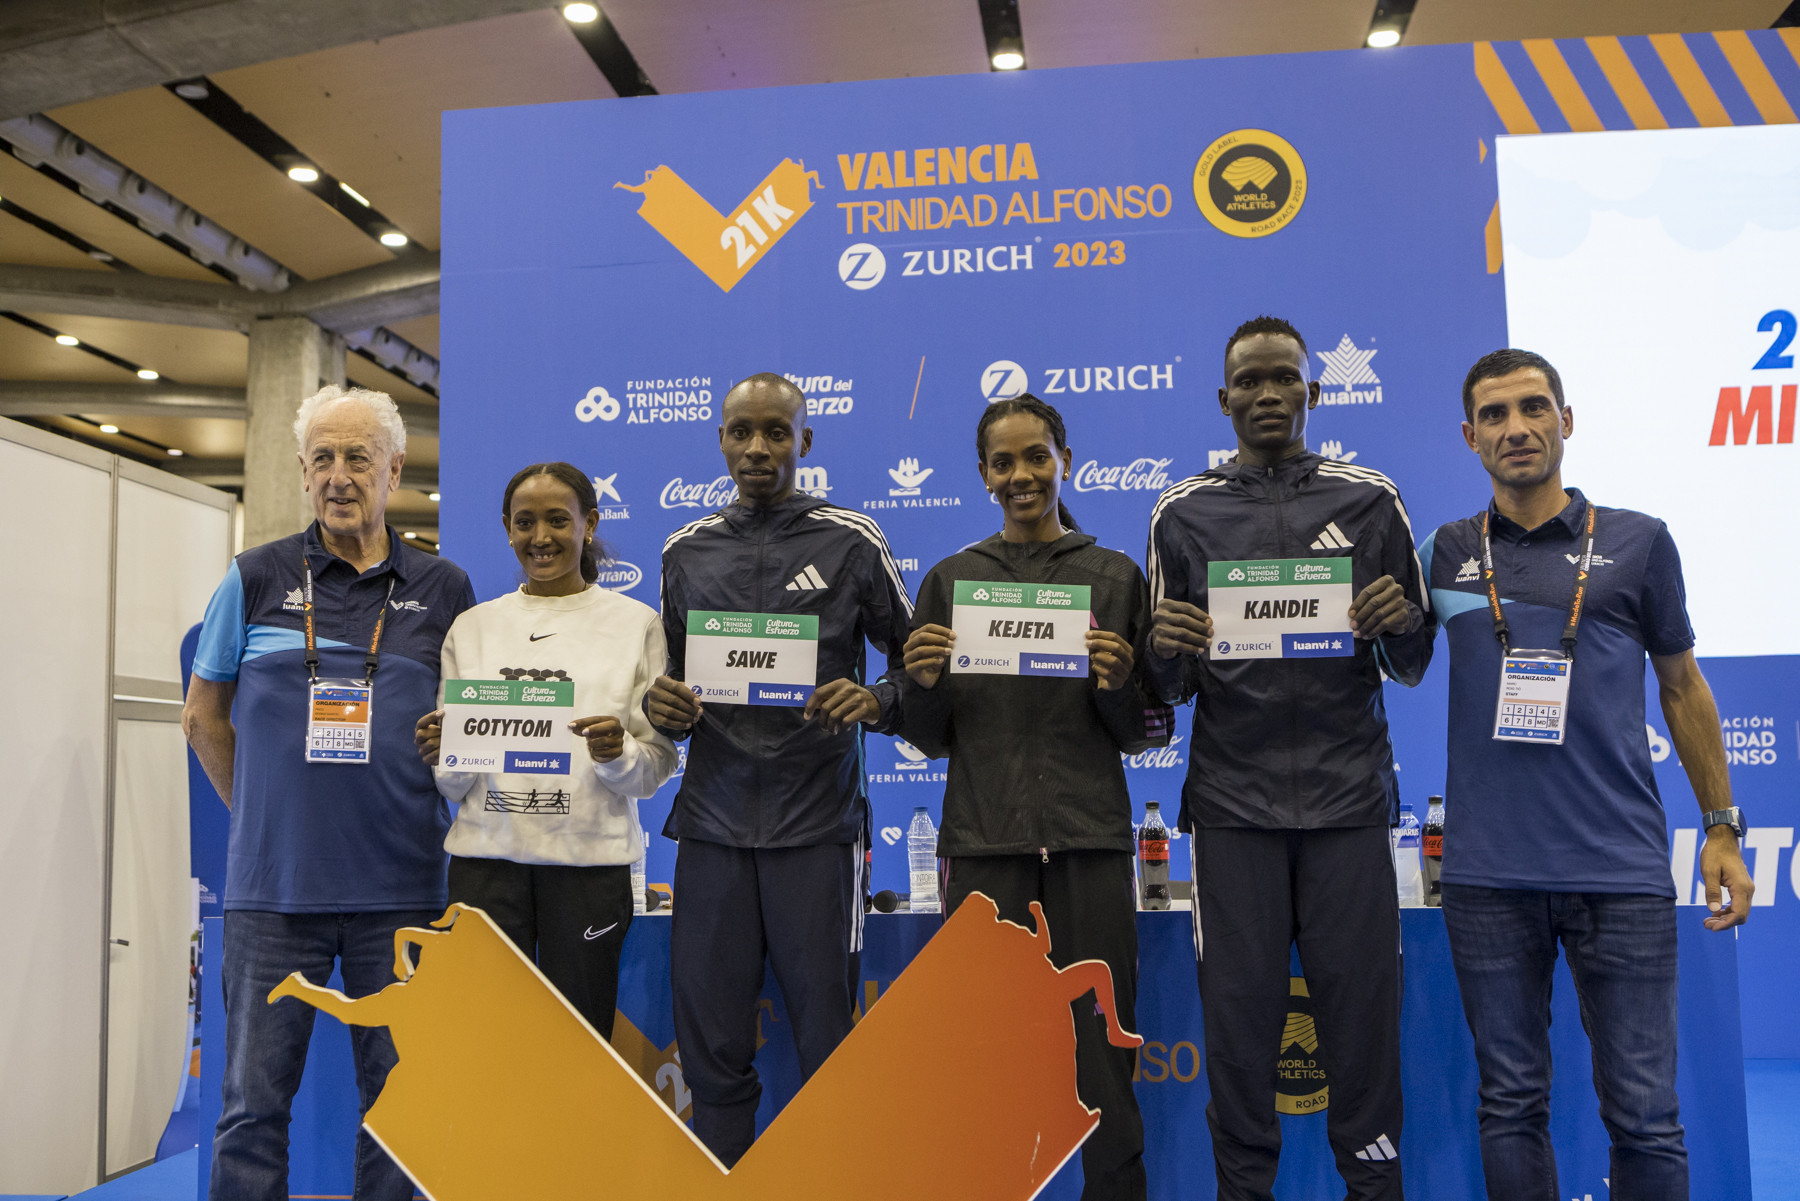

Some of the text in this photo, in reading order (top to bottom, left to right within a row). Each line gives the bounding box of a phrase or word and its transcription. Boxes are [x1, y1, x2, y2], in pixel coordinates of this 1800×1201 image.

[1199, 136, 1239, 177] GOLD LABEL
[837, 142, 1039, 191] VALENCIA
[1234, 193, 1268, 203] WORLD
[836, 183, 1172, 235] TRINIDAD ALFONSO
[1226, 201, 1276, 211] ATHLETICS
[1250, 179, 1302, 233] ROAD RACE 2023
[720, 184, 795, 269] 21K
[902, 245, 1033, 276] ZURICH
[1053, 240, 1126, 268] 2023
[627, 376, 711, 391] FUNDACIÓN
[1044, 364, 1174, 393] ZURICH
[833, 379, 853, 391] del
[626, 390, 712, 408] TRINIDAD
[806, 396, 853, 416] erzo
[626, 406, 712, 424] ALFONSO
[1074, 458, 1174, 492] Coca-Cola
[659, 476, 740, 509] Coca-Col
[863, 497, 961, 509] FERIA VALENCIA
[599, 508, 630, 520] aBank
[1295, 564, 1324, 572] Cultura
[1294, 572, 1332, 581] Esfuerzo
[1037, 589, 1065, 598] Cultura
[1036, 596, 1071, 606] Esfuerzo
[1490, 583, 1501, 620] #MadeToRun
[1570, 586, 1583, 626] #MadeToRun
[1244, 599, 1319, 620] KANDIE
[767, 619, 793, 628] Cultura
[988, 619, 1054, 640] KEJETA
[306, 616, 314, 650] #MadeToRun
[766, 626, 799, 635] Esfuerzo
[1235, 643, 1272, 651] ZURICH
[1293, 640, 1329, 650] luanvi
[726, 650, 777, 669] SAWE
[974, 658, 1010, 666] ZURICH
[1030, 660, 1064, 670] luanvi
[522, 694, 556, 702] Esfuerzo
[706, 688, 739, 696] ZURICH
[759, 690, 792, 700] luanvi
[1722, 715, 1774, 728] ACIÓN
[463, 718, 552, 738] GOTYTOM
[1724, 731, 1776, 748] IDAD
[515, 758, 547, 768] luanvi
[869, 773, 947, 783] FERIA VALEN
[1392, 828, 1420, 838] AQUARIUS
[1277, 1060, 1316, 1068] WORLD
[1278, 1070, 1326, 1079] HLETICS
[1296, 1095, 1326, 1108] ROAD
